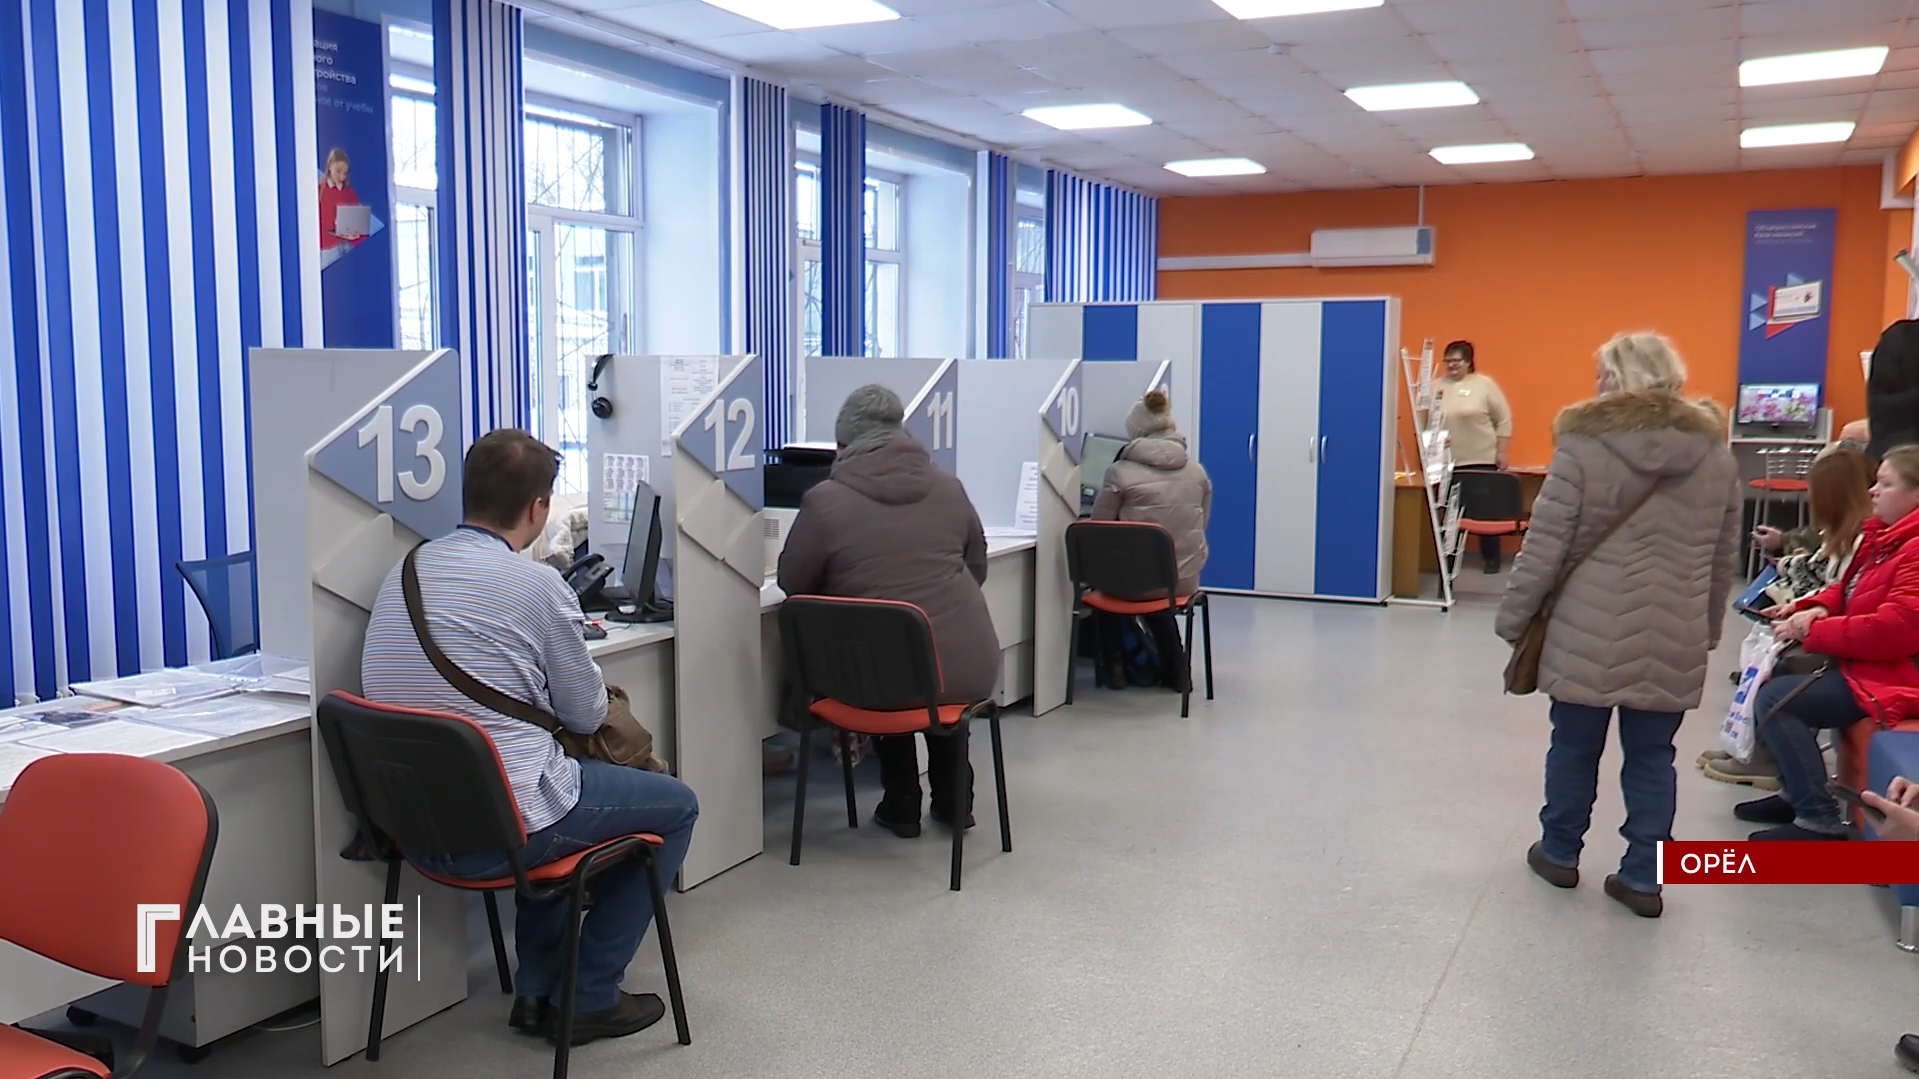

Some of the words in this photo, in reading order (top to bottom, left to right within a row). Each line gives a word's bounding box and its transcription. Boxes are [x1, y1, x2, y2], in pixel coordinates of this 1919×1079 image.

[315, 55, 333, 65] ого
[704, 398, 756, 473] 12
[927, 391, 953, 450] 11
[1057, 387, 1079, 437] 10
[358, 404, 446, 503] 13
